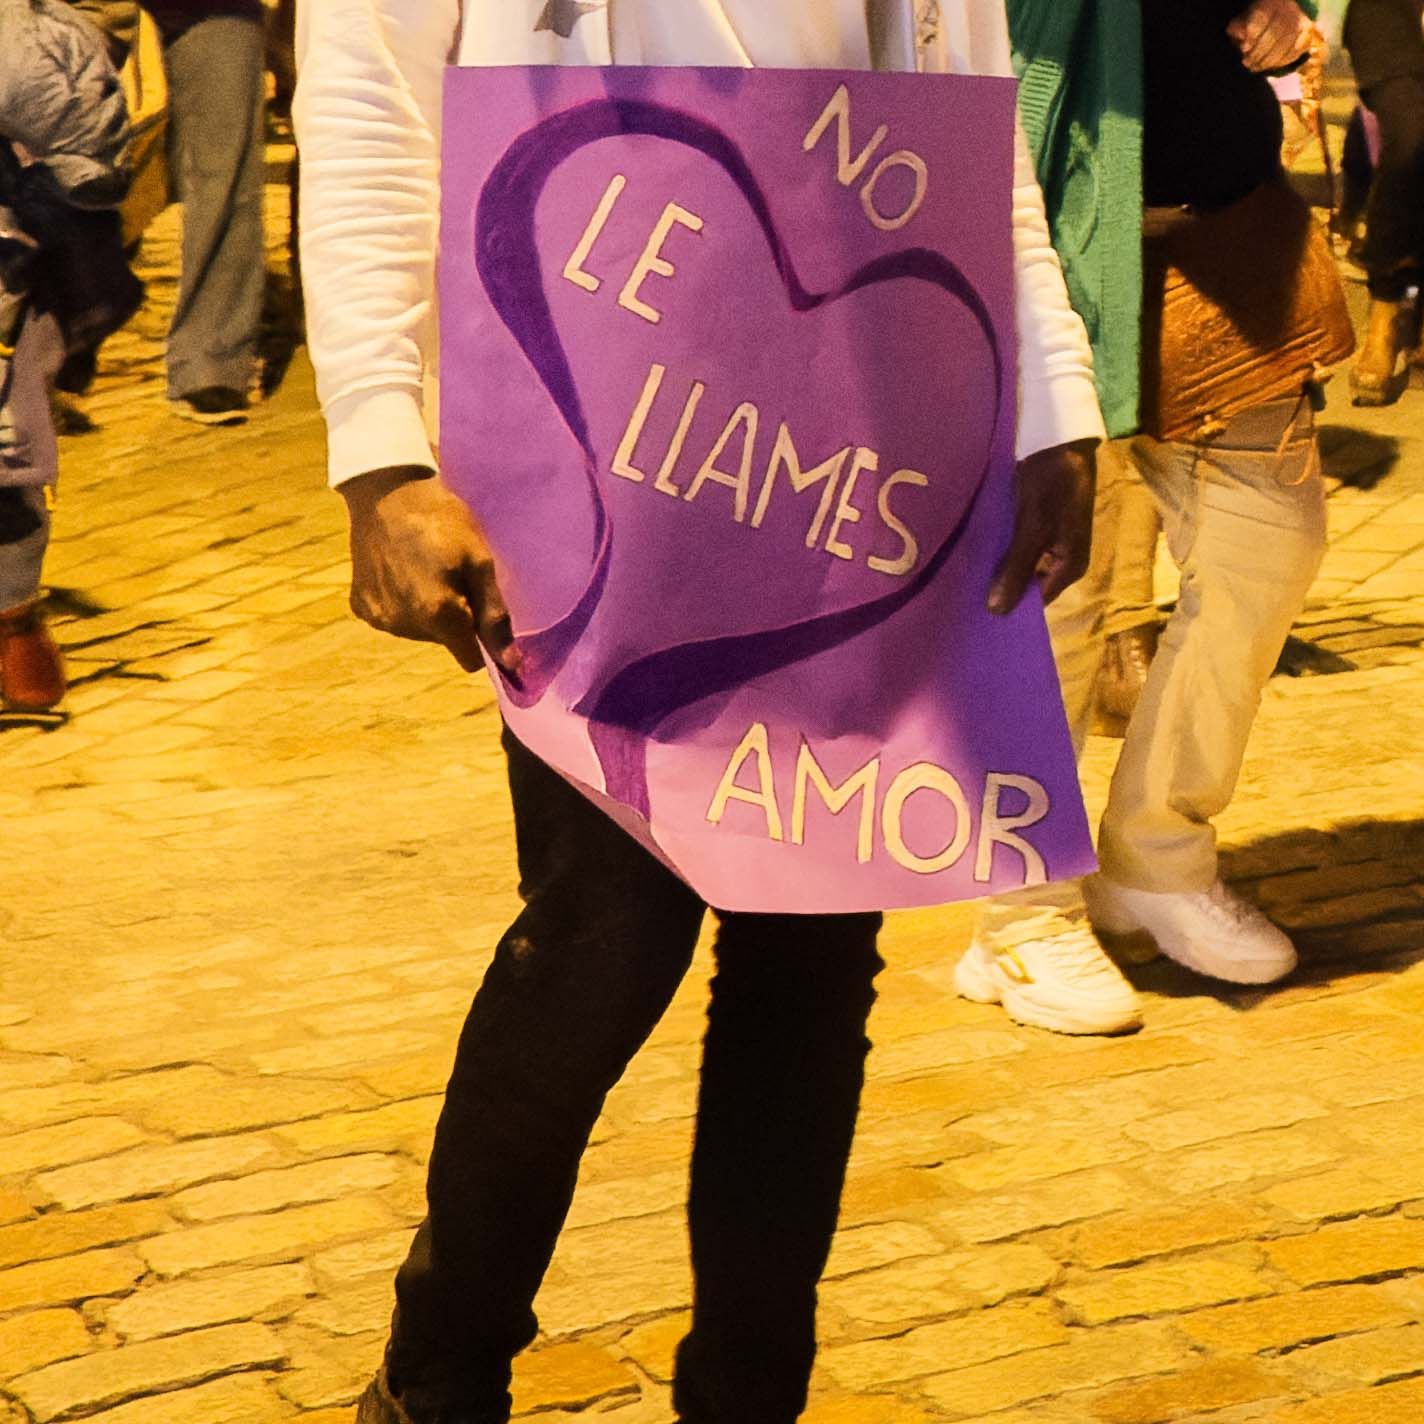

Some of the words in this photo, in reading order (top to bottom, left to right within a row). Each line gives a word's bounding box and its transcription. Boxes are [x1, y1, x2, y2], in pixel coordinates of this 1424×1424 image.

[802, 83, 930, 233] NO
[561, 173, 705, 325] LE
[608, 363, 930, 578] LLAMES
[705, 720, 1055, 887] AMOR
